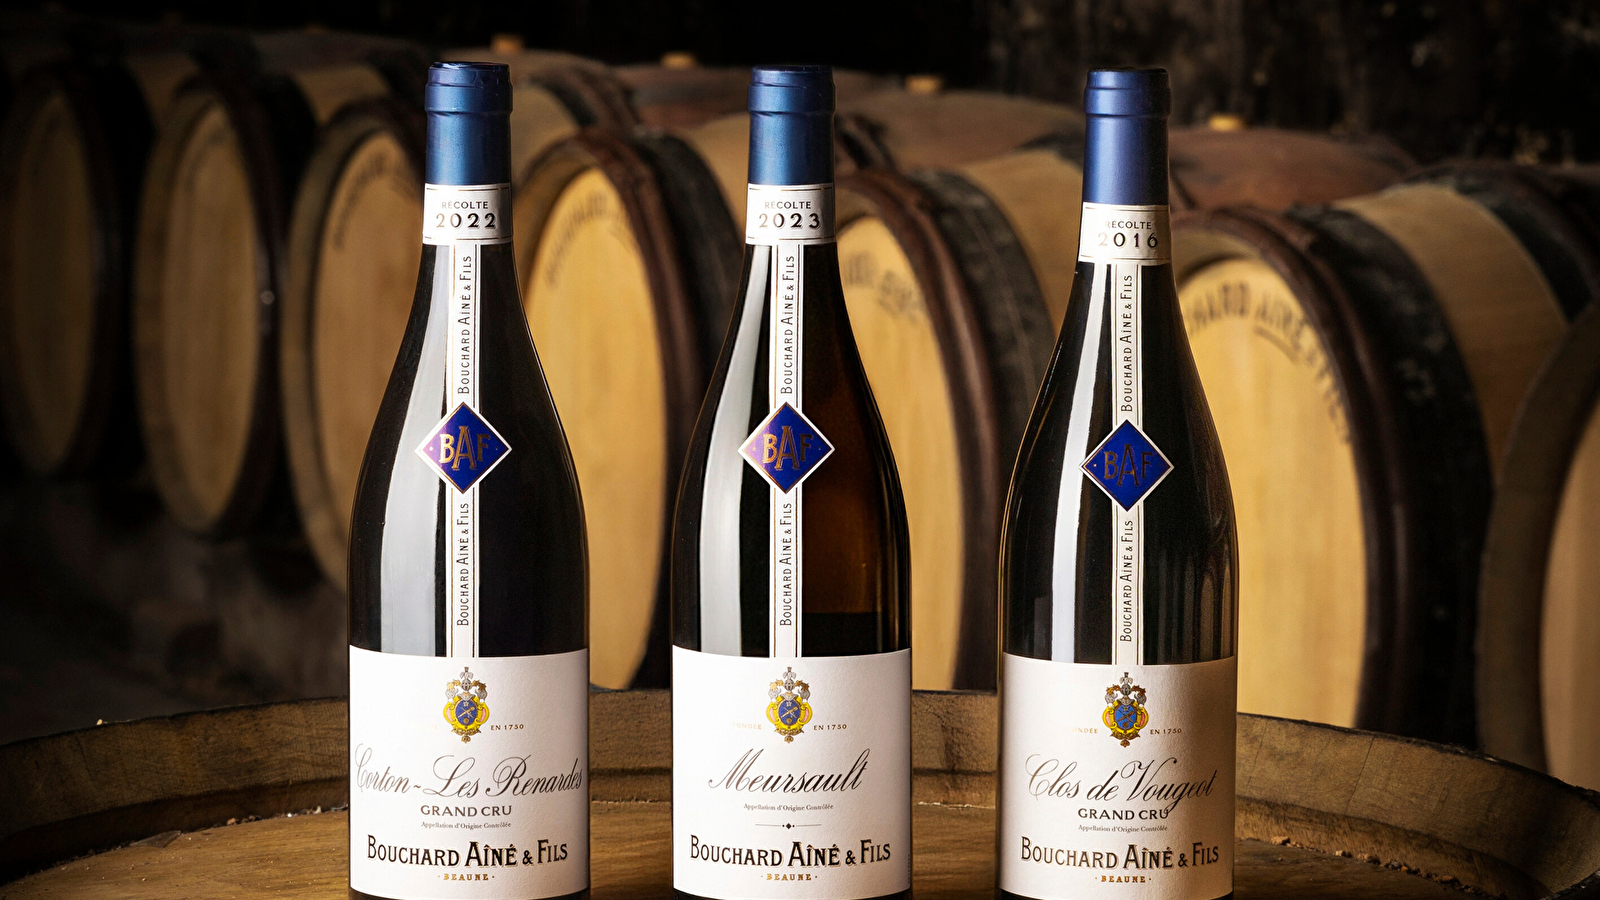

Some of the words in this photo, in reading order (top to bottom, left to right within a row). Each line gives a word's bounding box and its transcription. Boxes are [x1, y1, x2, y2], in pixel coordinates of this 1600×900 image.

[435, 212, 496, 229] 2022
[758, 212, 820, 229] 2023
[1098, 232, 1158, 248] 2016
[460, 255, 472, 281] FILS
[782, 255, 795, 281] FILS
[1120, 275, 1133, 300] FILS
[439, 425, 491, 471] BAF
[762, 425, 814, 471] BAF
[1104, 444, 1153, 486] BAF
[456, 502, 469, 526] FILS
[780, 502, 792, 526] FILS
[1121, 520, 1133, 543] FILS
[485, 754, 583, 798] Renardes
[708, 748, 870, 793] Meursault
[1025, 753, 1082, 802] Clos
[1086, 770, 1120, 802] de
[1120, 756, 1218, 816] Vougeot
[420, 805, 478, 817] GRAND
[481, 805, 512, 816] CRU
[743, 803, 776, 811] Appellation
[1078, 808, 1135, 820] GRAND
[1139, 810, 1169, 820] CRU
[421, 821, 452, 830] Appellation
[1078, 824, 1110, 832] Appellation
[367, 834, 460, 867] BOUCHARD
[522, 851, 533, 865] &
[537, 838, 568, 864] FILS
[690, 834, 783, 867] BOUCHARD
[845, 851, 856, 865] &
[860, 838, 891, 864] FILS
[1021, 836, 1119, 869] BOUCHARD
[1178, 853, 1188, 867] &
[1192, 842, 1219, 866] FILS
[444, 873, 489, 881] BEAUNE
[766, 873, 812, 881] BEAUNE
[1101, 875, 1146, 883] BEAUNE
